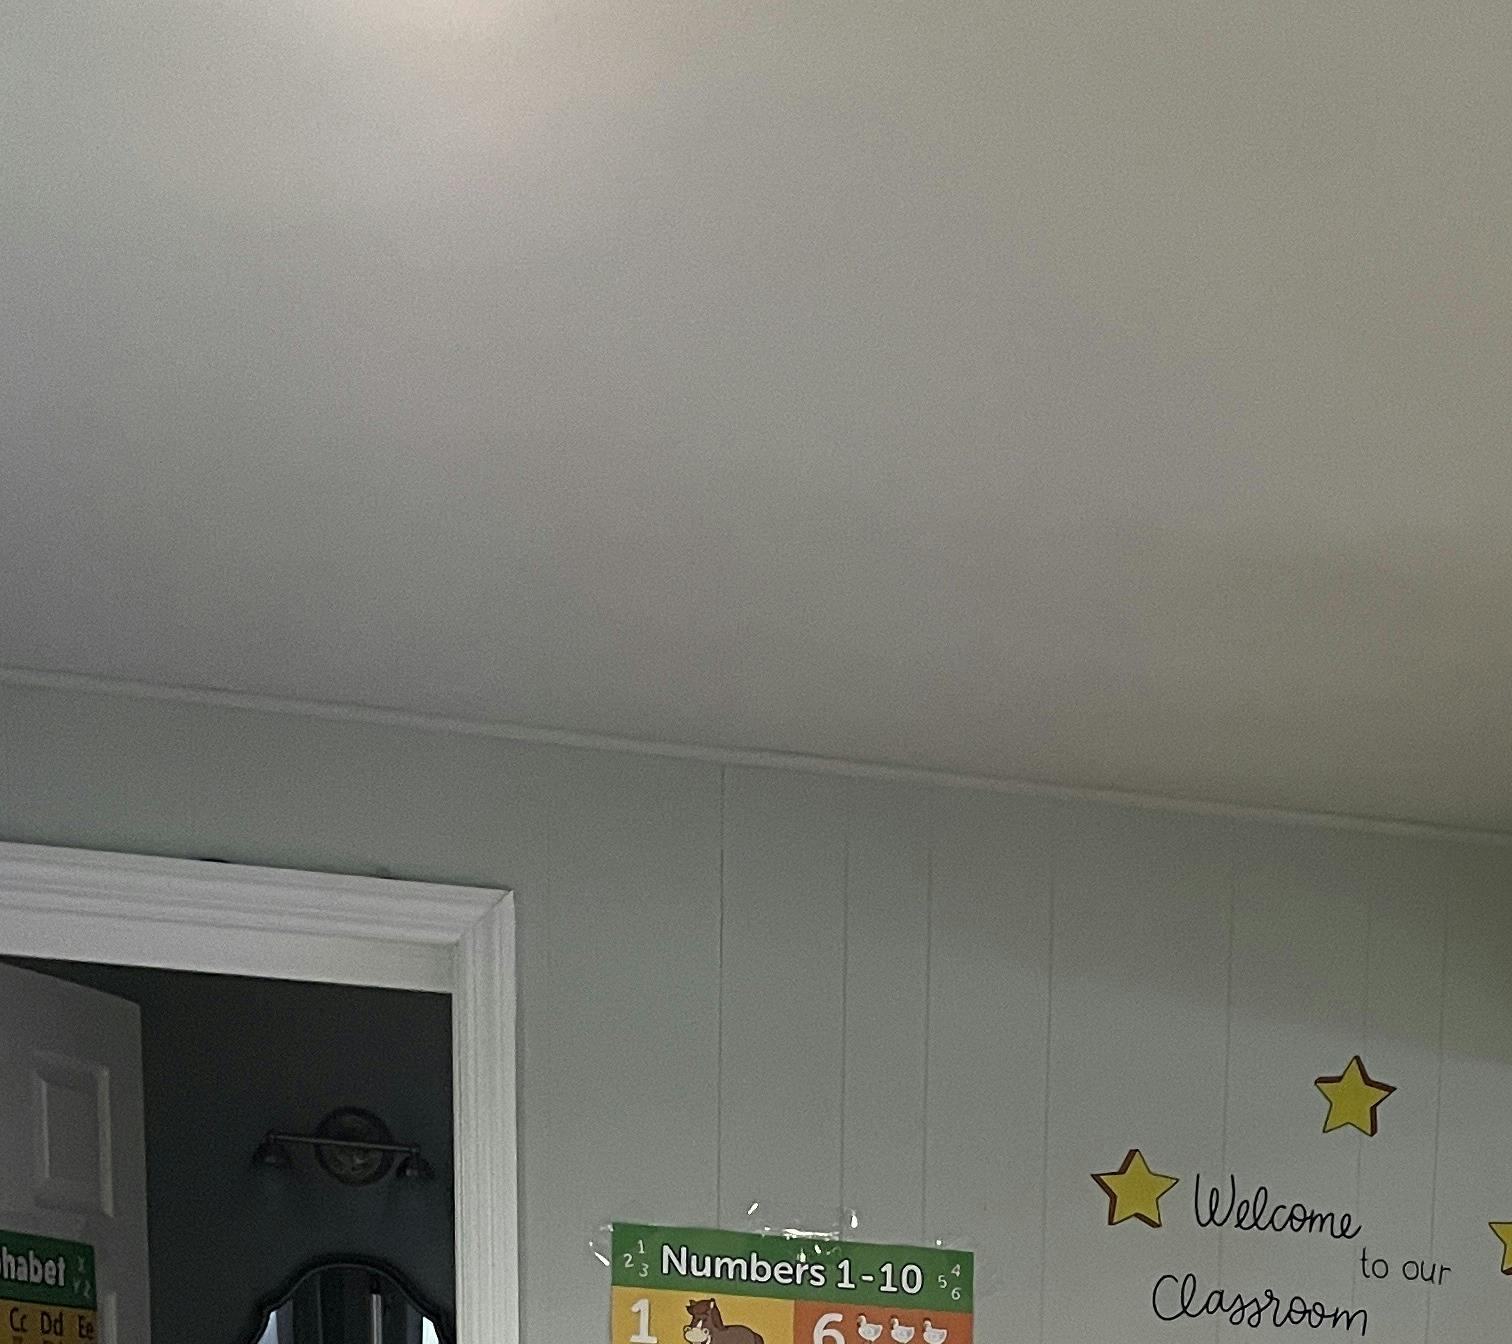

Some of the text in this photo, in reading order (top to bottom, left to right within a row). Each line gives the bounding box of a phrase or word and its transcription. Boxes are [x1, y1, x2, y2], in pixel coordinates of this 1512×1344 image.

[1194, 1173, 1362, 1240] Welcome
[660, 1243, 924, 1294] Numbers 1-10
[1360, 1248, 1452, 1286] to our
[631, 1301, 658, 1344] 1
[1152, 1273, 1368, 1336] Classroom
